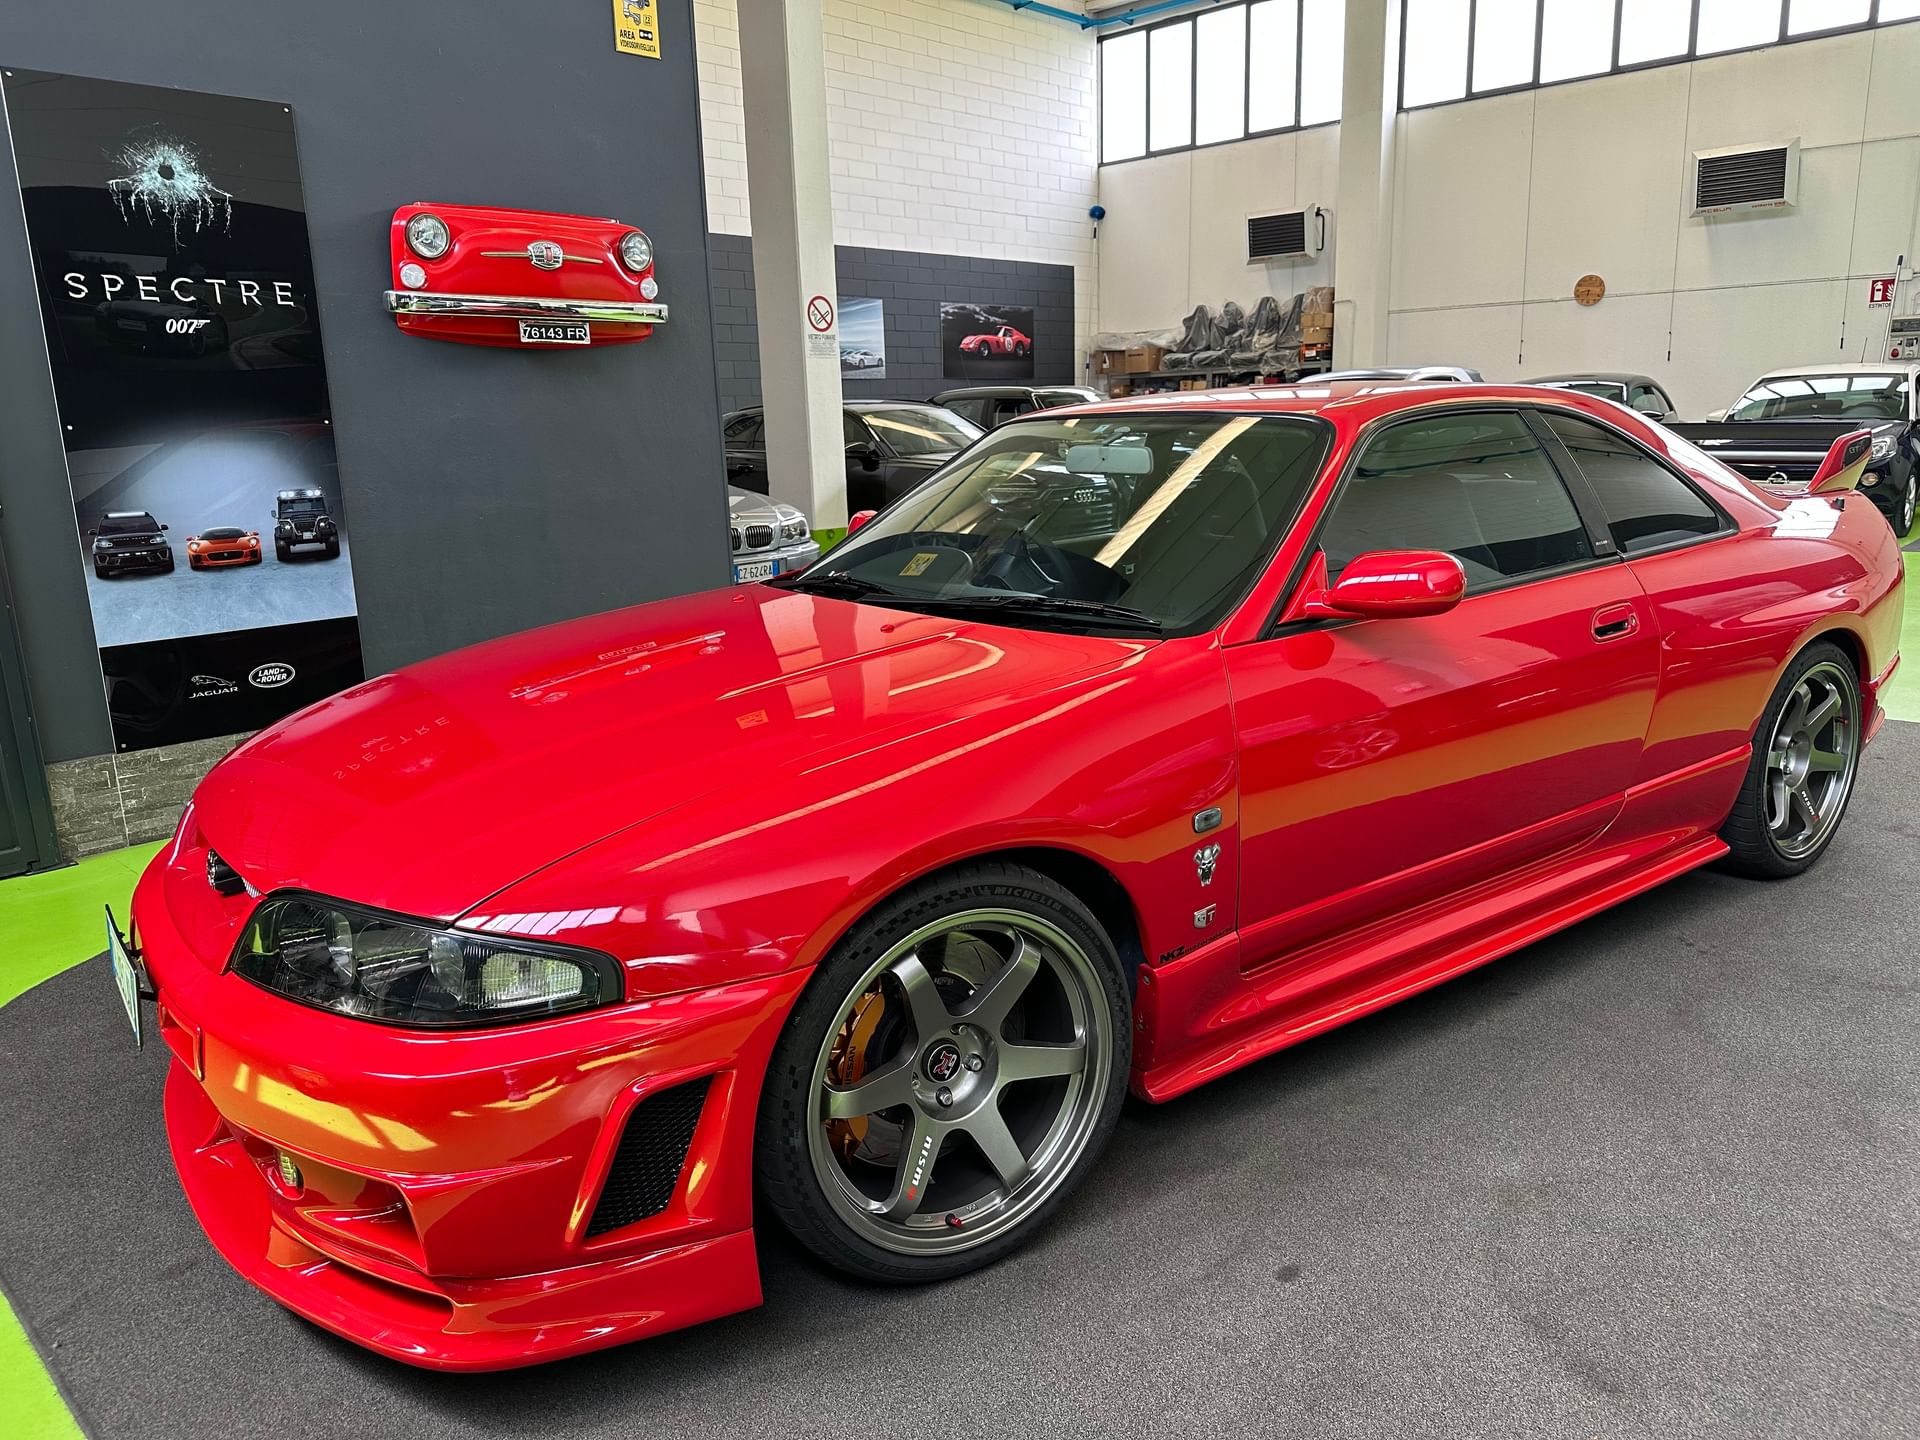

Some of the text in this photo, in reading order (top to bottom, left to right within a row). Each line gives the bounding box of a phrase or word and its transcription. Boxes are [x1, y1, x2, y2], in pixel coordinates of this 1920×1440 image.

[620, 29, 635, 40] AREA
[64, 272, 296, 307] SPECTRE
[165, 318, 211, 334] 007
[523, 327, 586, 339] 76143 FR
[258, 668, 280, 677] LAND
[261, 673, 287, 683] ROVER
[188, 686, 239, 699] JAGUAR
[994, 886, 1062, 912] MICHELIN
[843, 1046, 857, 1085] ISSAN
